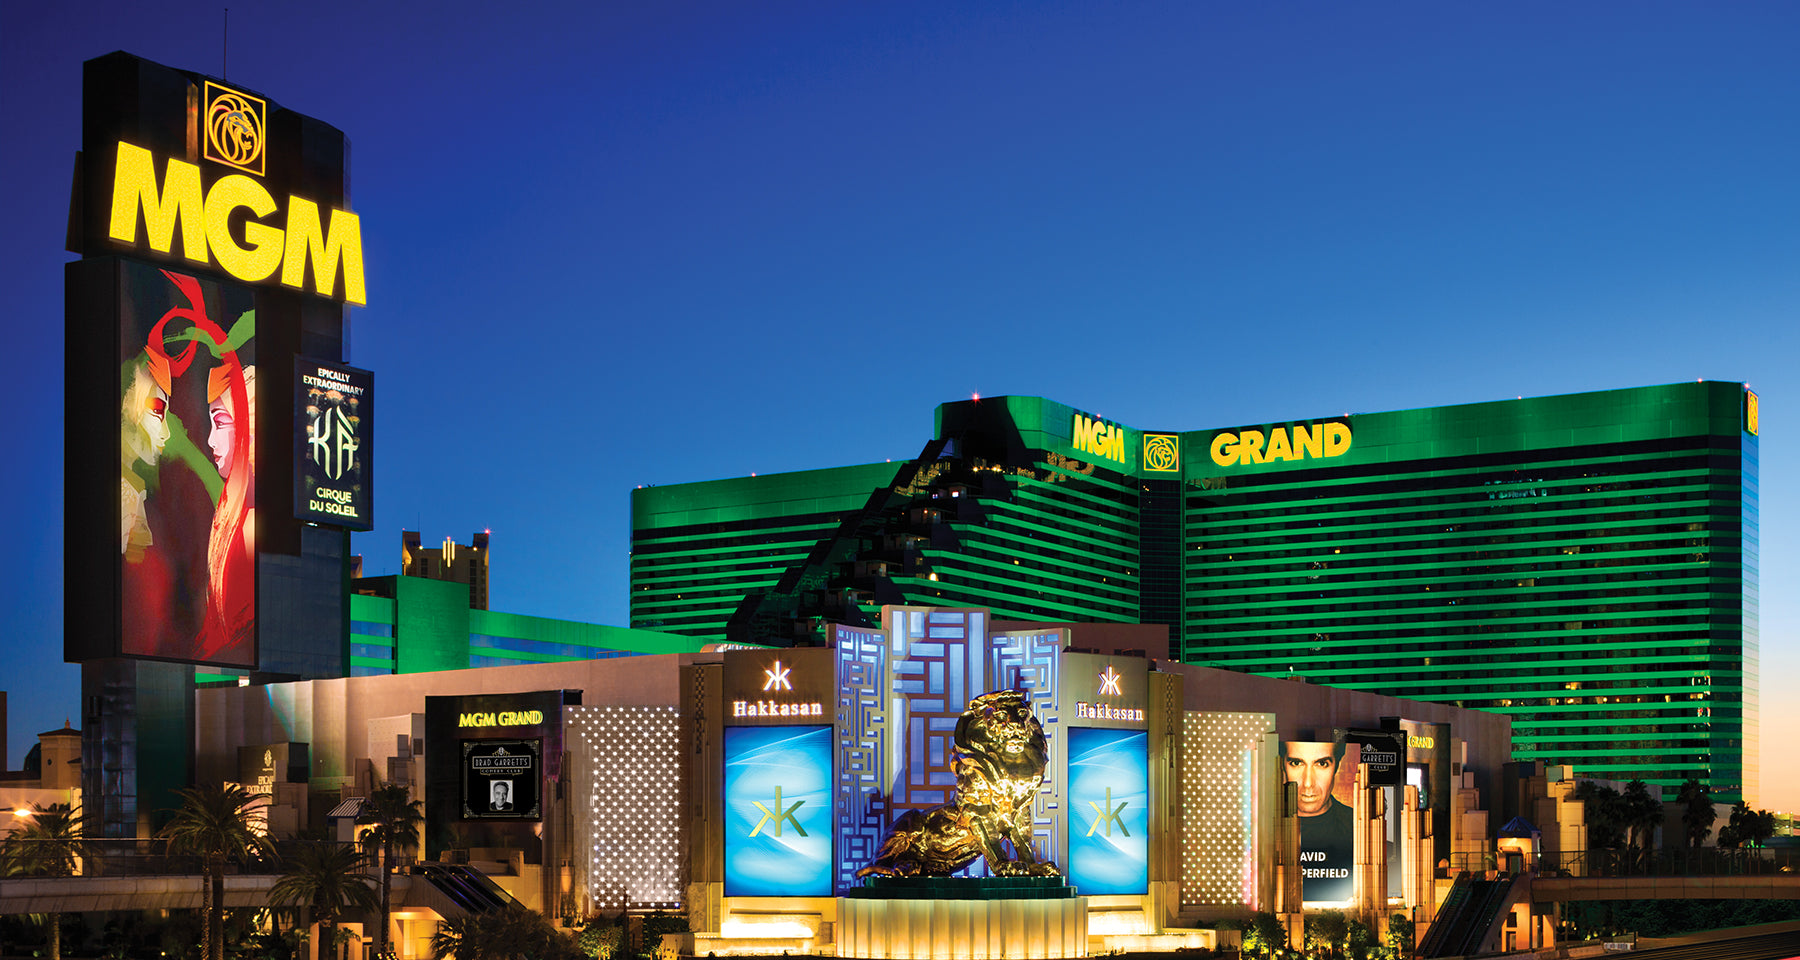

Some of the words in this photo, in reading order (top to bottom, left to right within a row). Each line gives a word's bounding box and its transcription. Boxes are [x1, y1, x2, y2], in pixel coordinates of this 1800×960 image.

[109, 141, 366, 305] MGM
[317, 368, 351, 383] EPICALLY
[303, 375, 364, 396] EXTRAORDINARY
[1073, 414, 1125, 464] MGM
[1210, 422, 1352, 467] GRAND
[316, 487, 352, 505] CIRQUE
[309, 500, 324, 512] DU
[325, 502, 358, 518] SOLEIL
[733, 700, 823, 717] Hakkasan
[1075, 701, 1144, 721] Hakkasan
[458, 712, 497, 728] MGM
[498, 710, 543, 726] GRAND
[475, 758, 491, 767] BRAD
